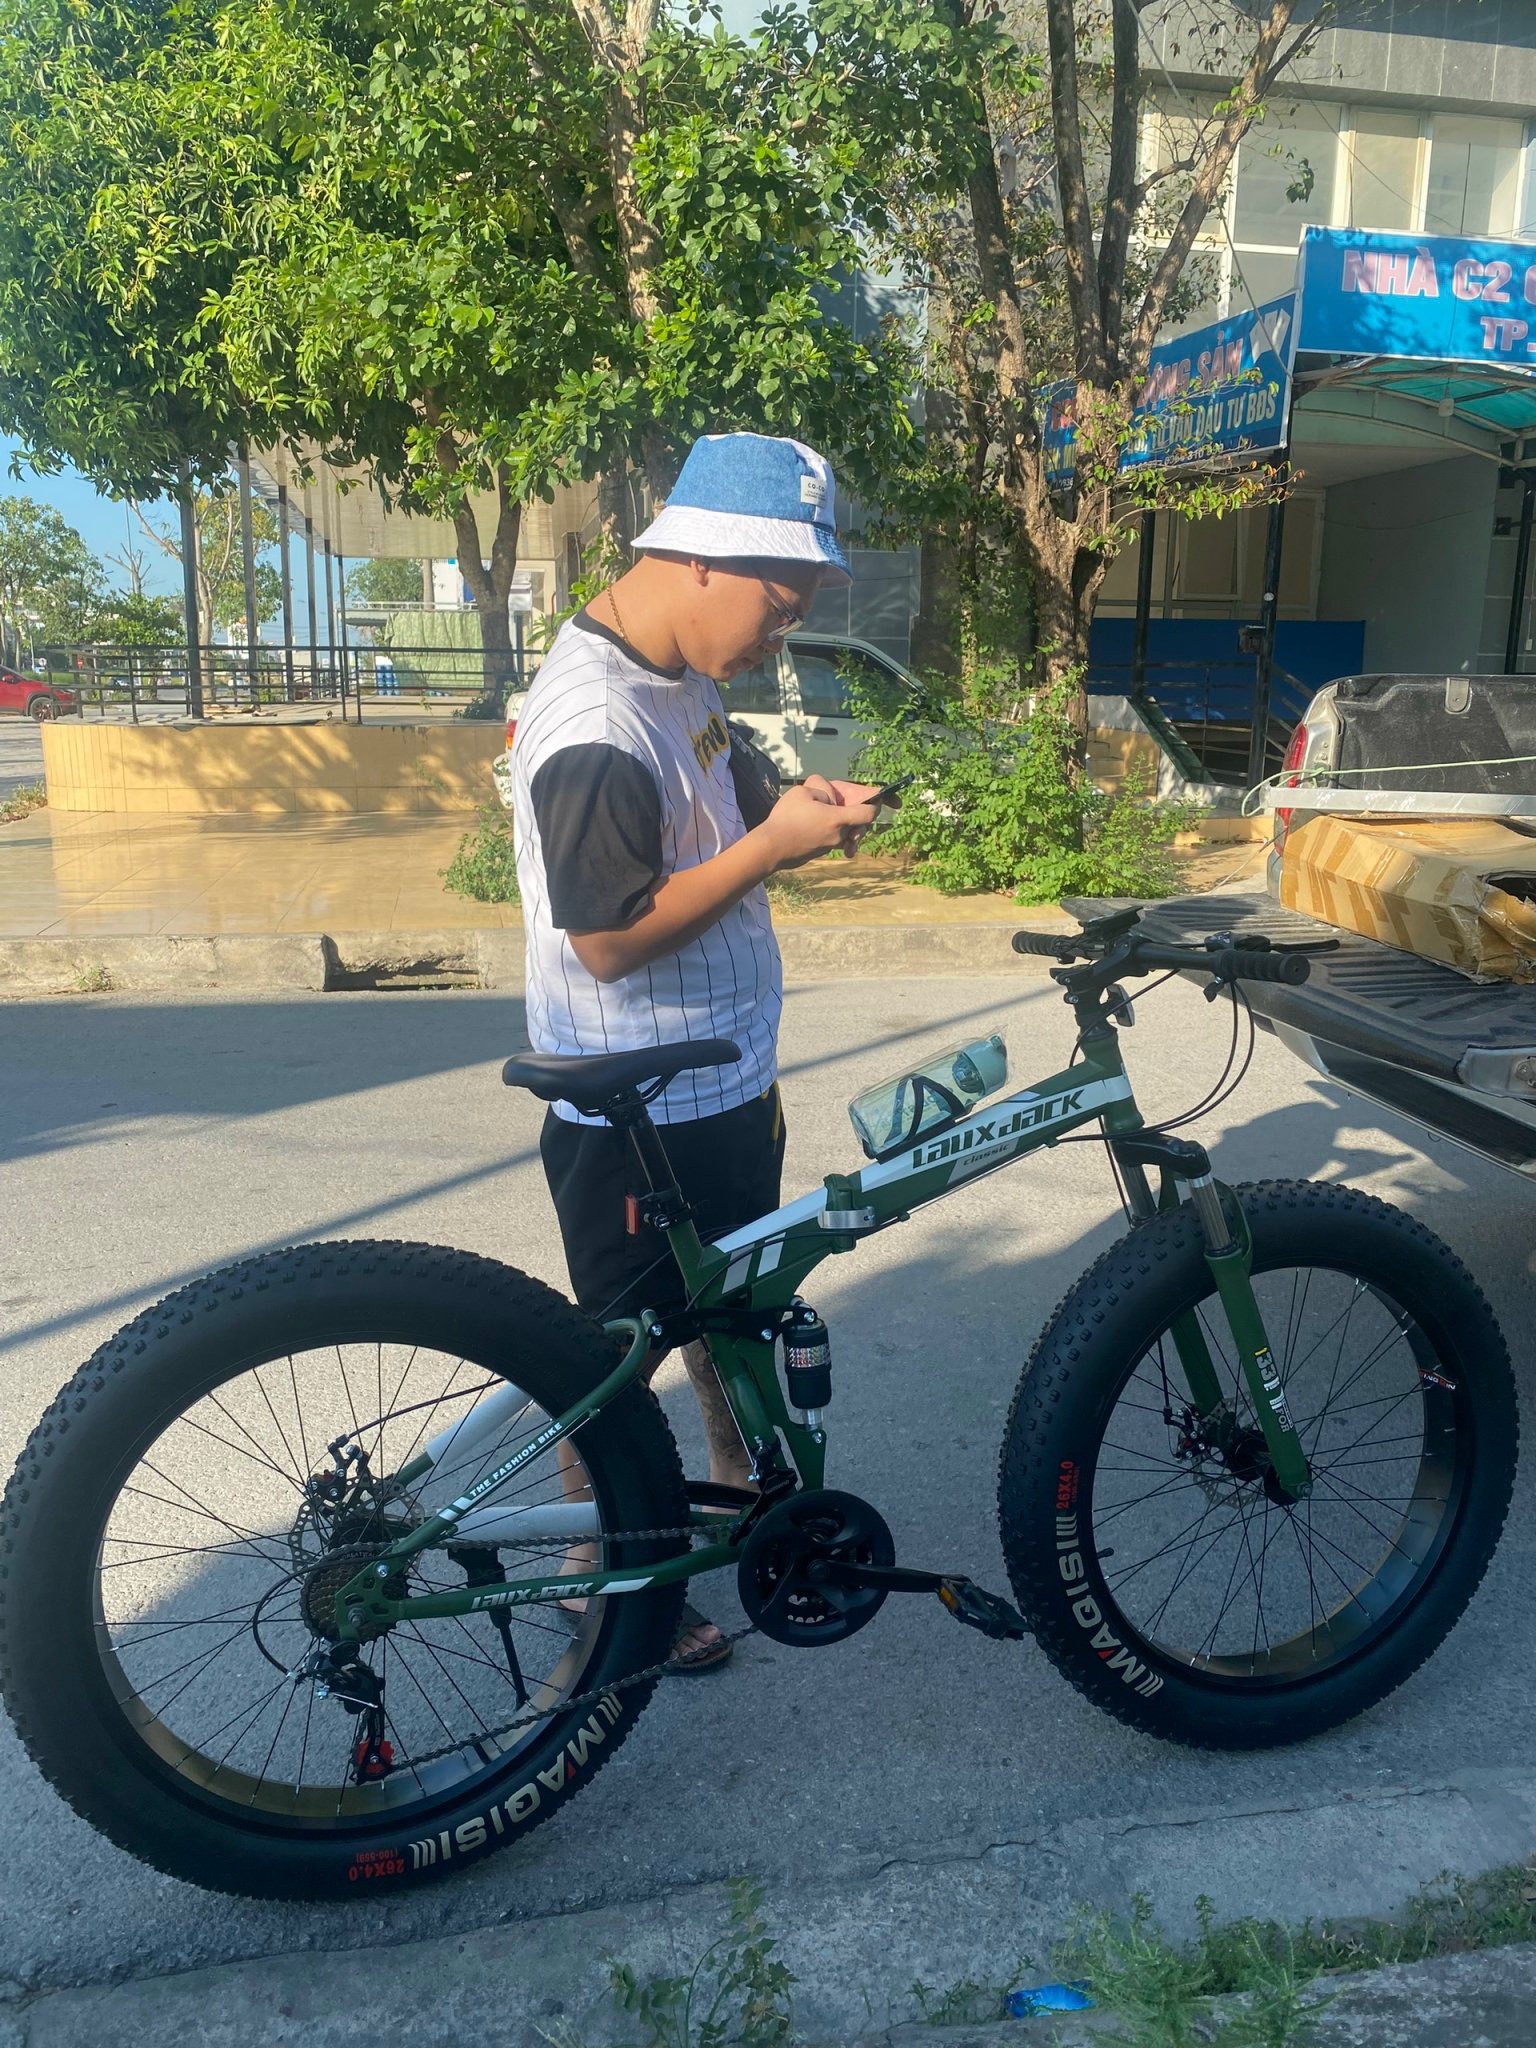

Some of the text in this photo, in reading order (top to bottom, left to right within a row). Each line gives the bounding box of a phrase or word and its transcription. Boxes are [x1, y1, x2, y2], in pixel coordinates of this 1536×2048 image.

[1341, 246, 1440, 298] NHÀ
[1452, 258, 1513, 303] C2
[469, 1422, 563, 1497] THE FASHION BIKE
